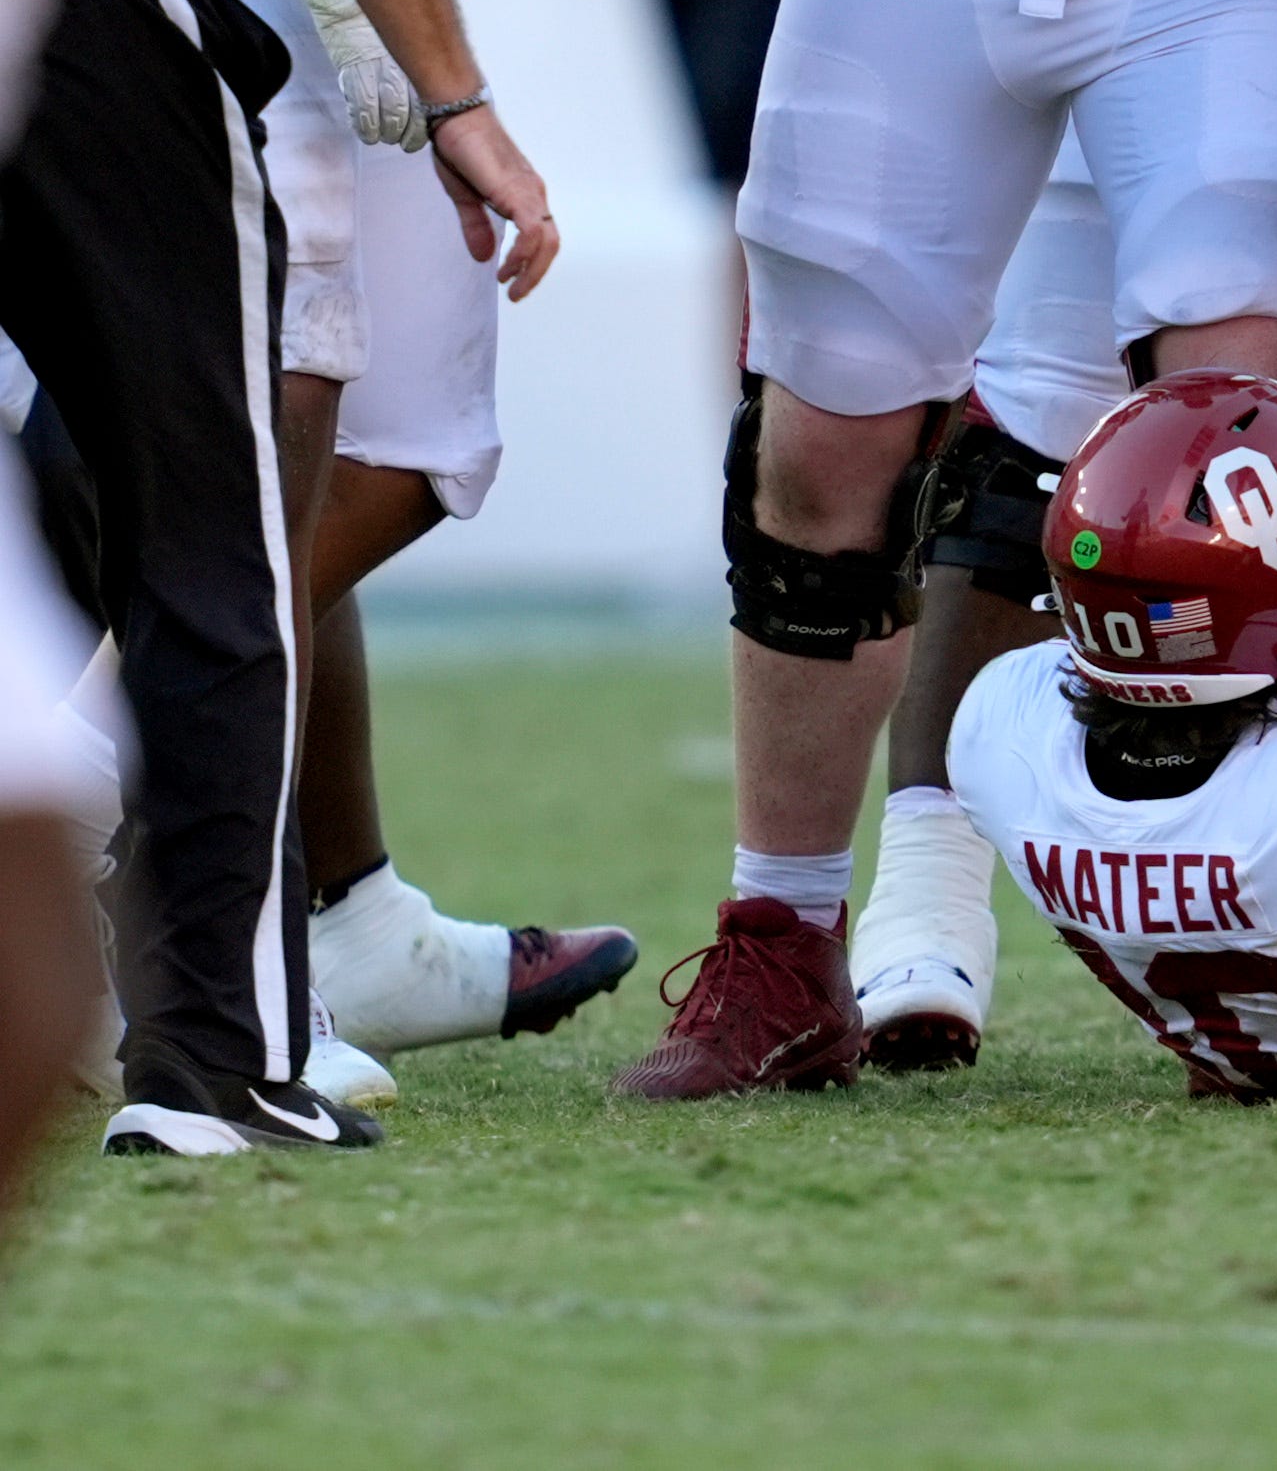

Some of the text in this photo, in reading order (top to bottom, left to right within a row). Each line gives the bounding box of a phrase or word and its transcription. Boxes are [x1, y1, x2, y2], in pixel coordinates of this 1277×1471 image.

[1074, 540, 1098, 557] C2P
[787, 624, 850, 636] DONJOY
[1074, 602, 1145, 658] 10
[1023, 841, 1256, 934] MATEER
